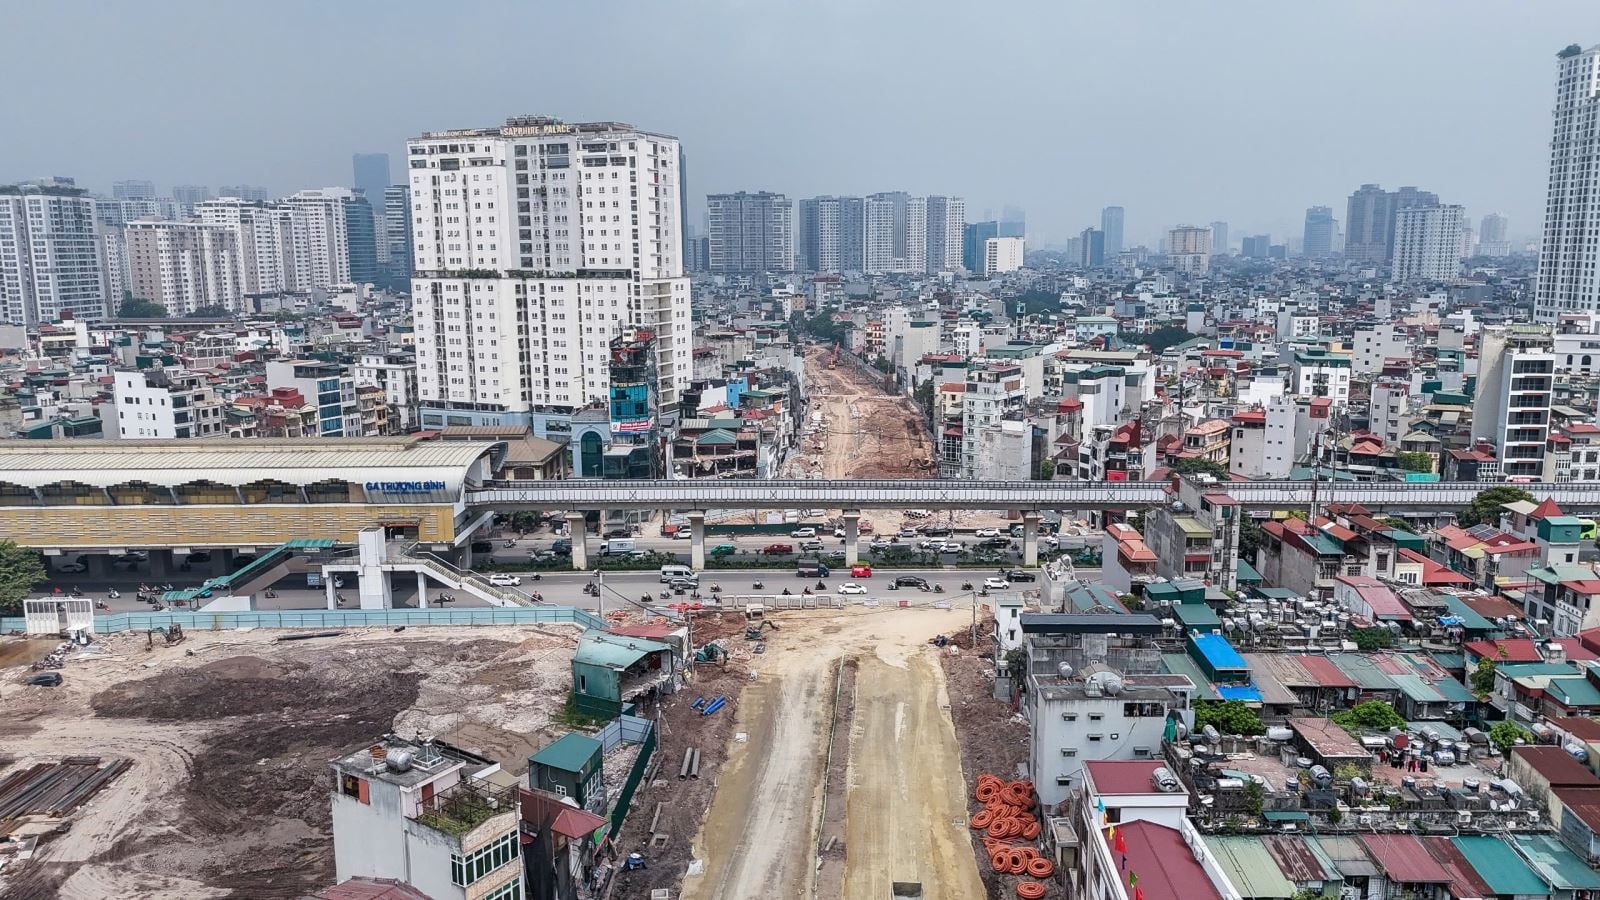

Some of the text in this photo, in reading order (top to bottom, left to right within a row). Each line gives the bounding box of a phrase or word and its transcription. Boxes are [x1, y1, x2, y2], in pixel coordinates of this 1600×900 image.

[503, 124, 571, 135] SAPPHIRE PALACE
[366, 482, 379, 490] GA
